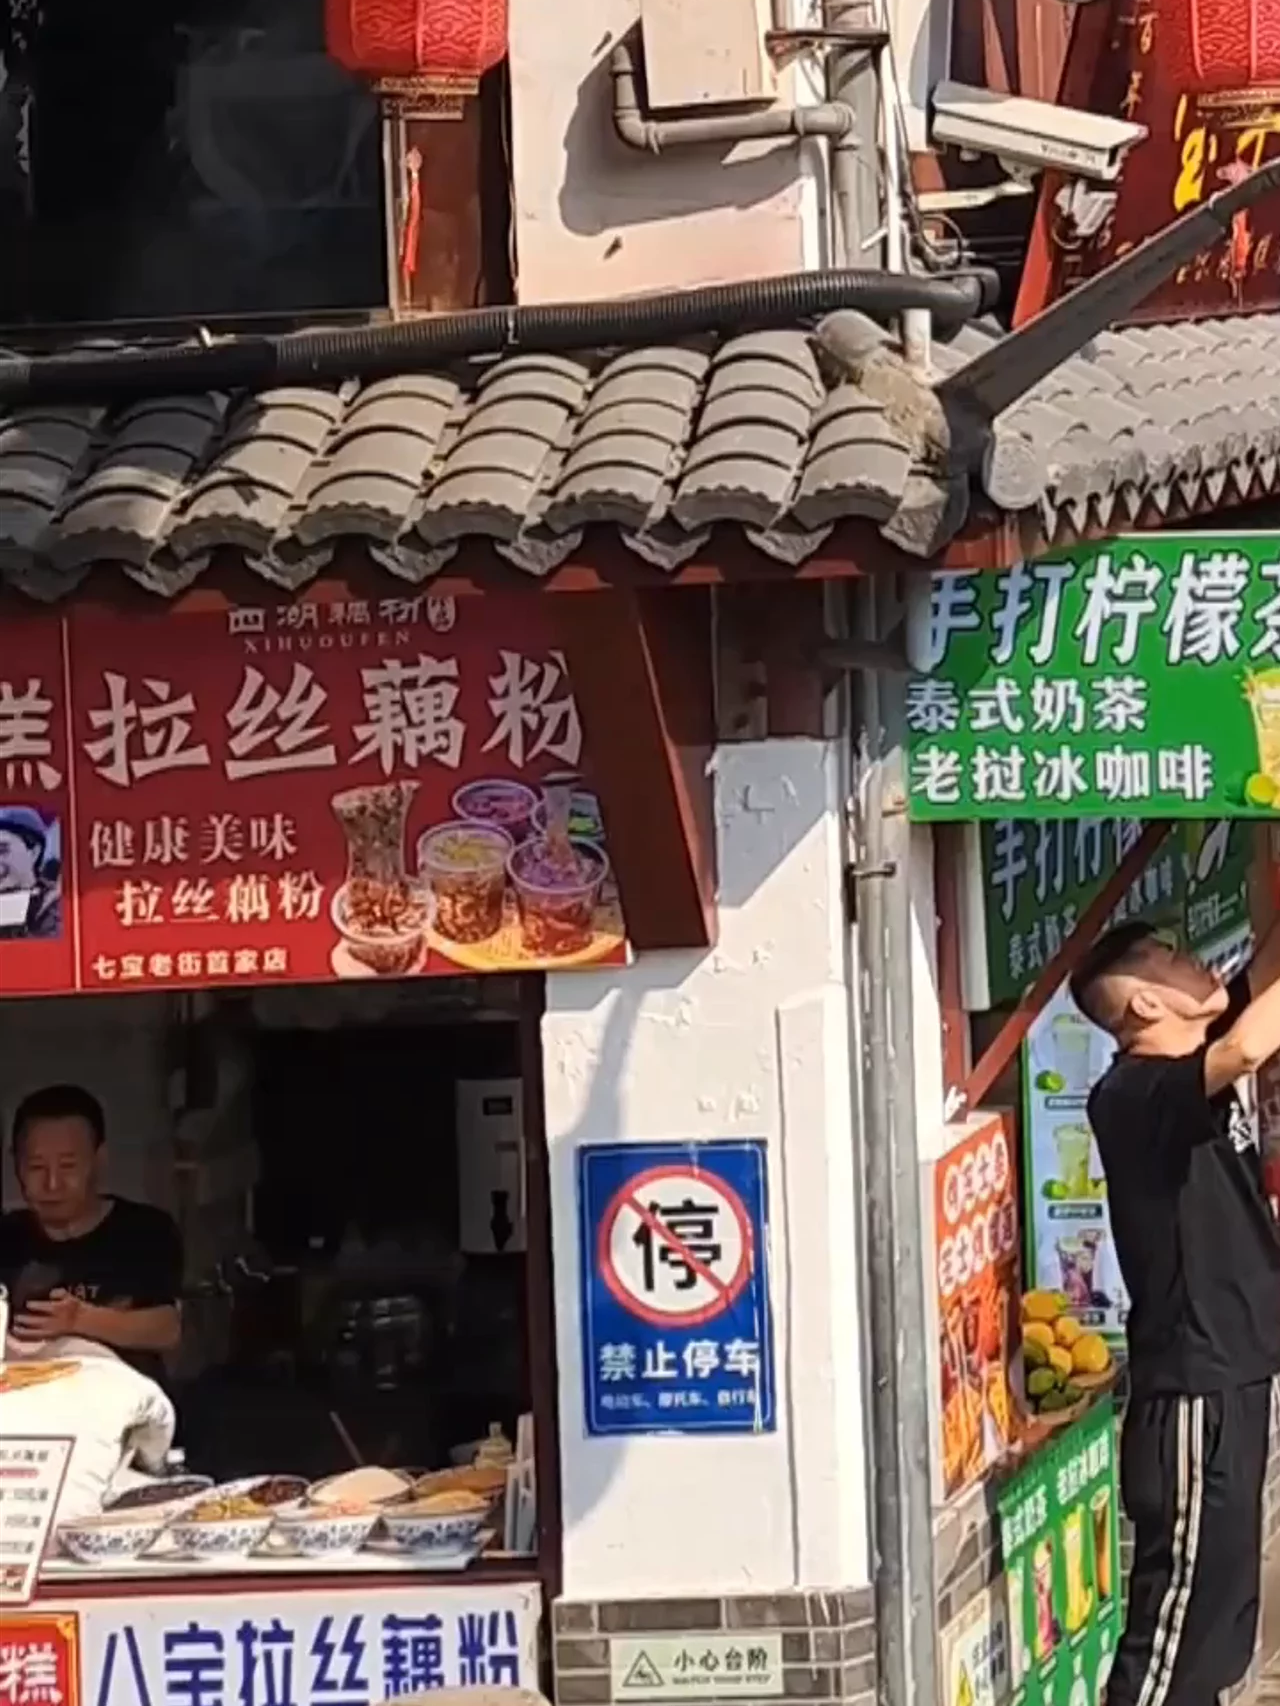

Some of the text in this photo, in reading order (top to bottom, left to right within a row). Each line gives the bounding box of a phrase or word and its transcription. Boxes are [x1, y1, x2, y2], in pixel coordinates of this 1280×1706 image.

[83, 649, 583, 787] 拉丝藕粉
[906, 677, 1148, 735] 泰式奶茶
[910, 745, 1215, 805] 老挝冰咖啡
[90, 812, 298, 868] 健康美味
[115, 870, 325, 926] 拉丝藕粉
[92, 947, 288, 979] 七宝老街首家店
[631, 1198, 722, 1292] 停
[600, 1339, 760, 1382] 禁止停车
[674, 1646, 768, 1673] 小心台阶
